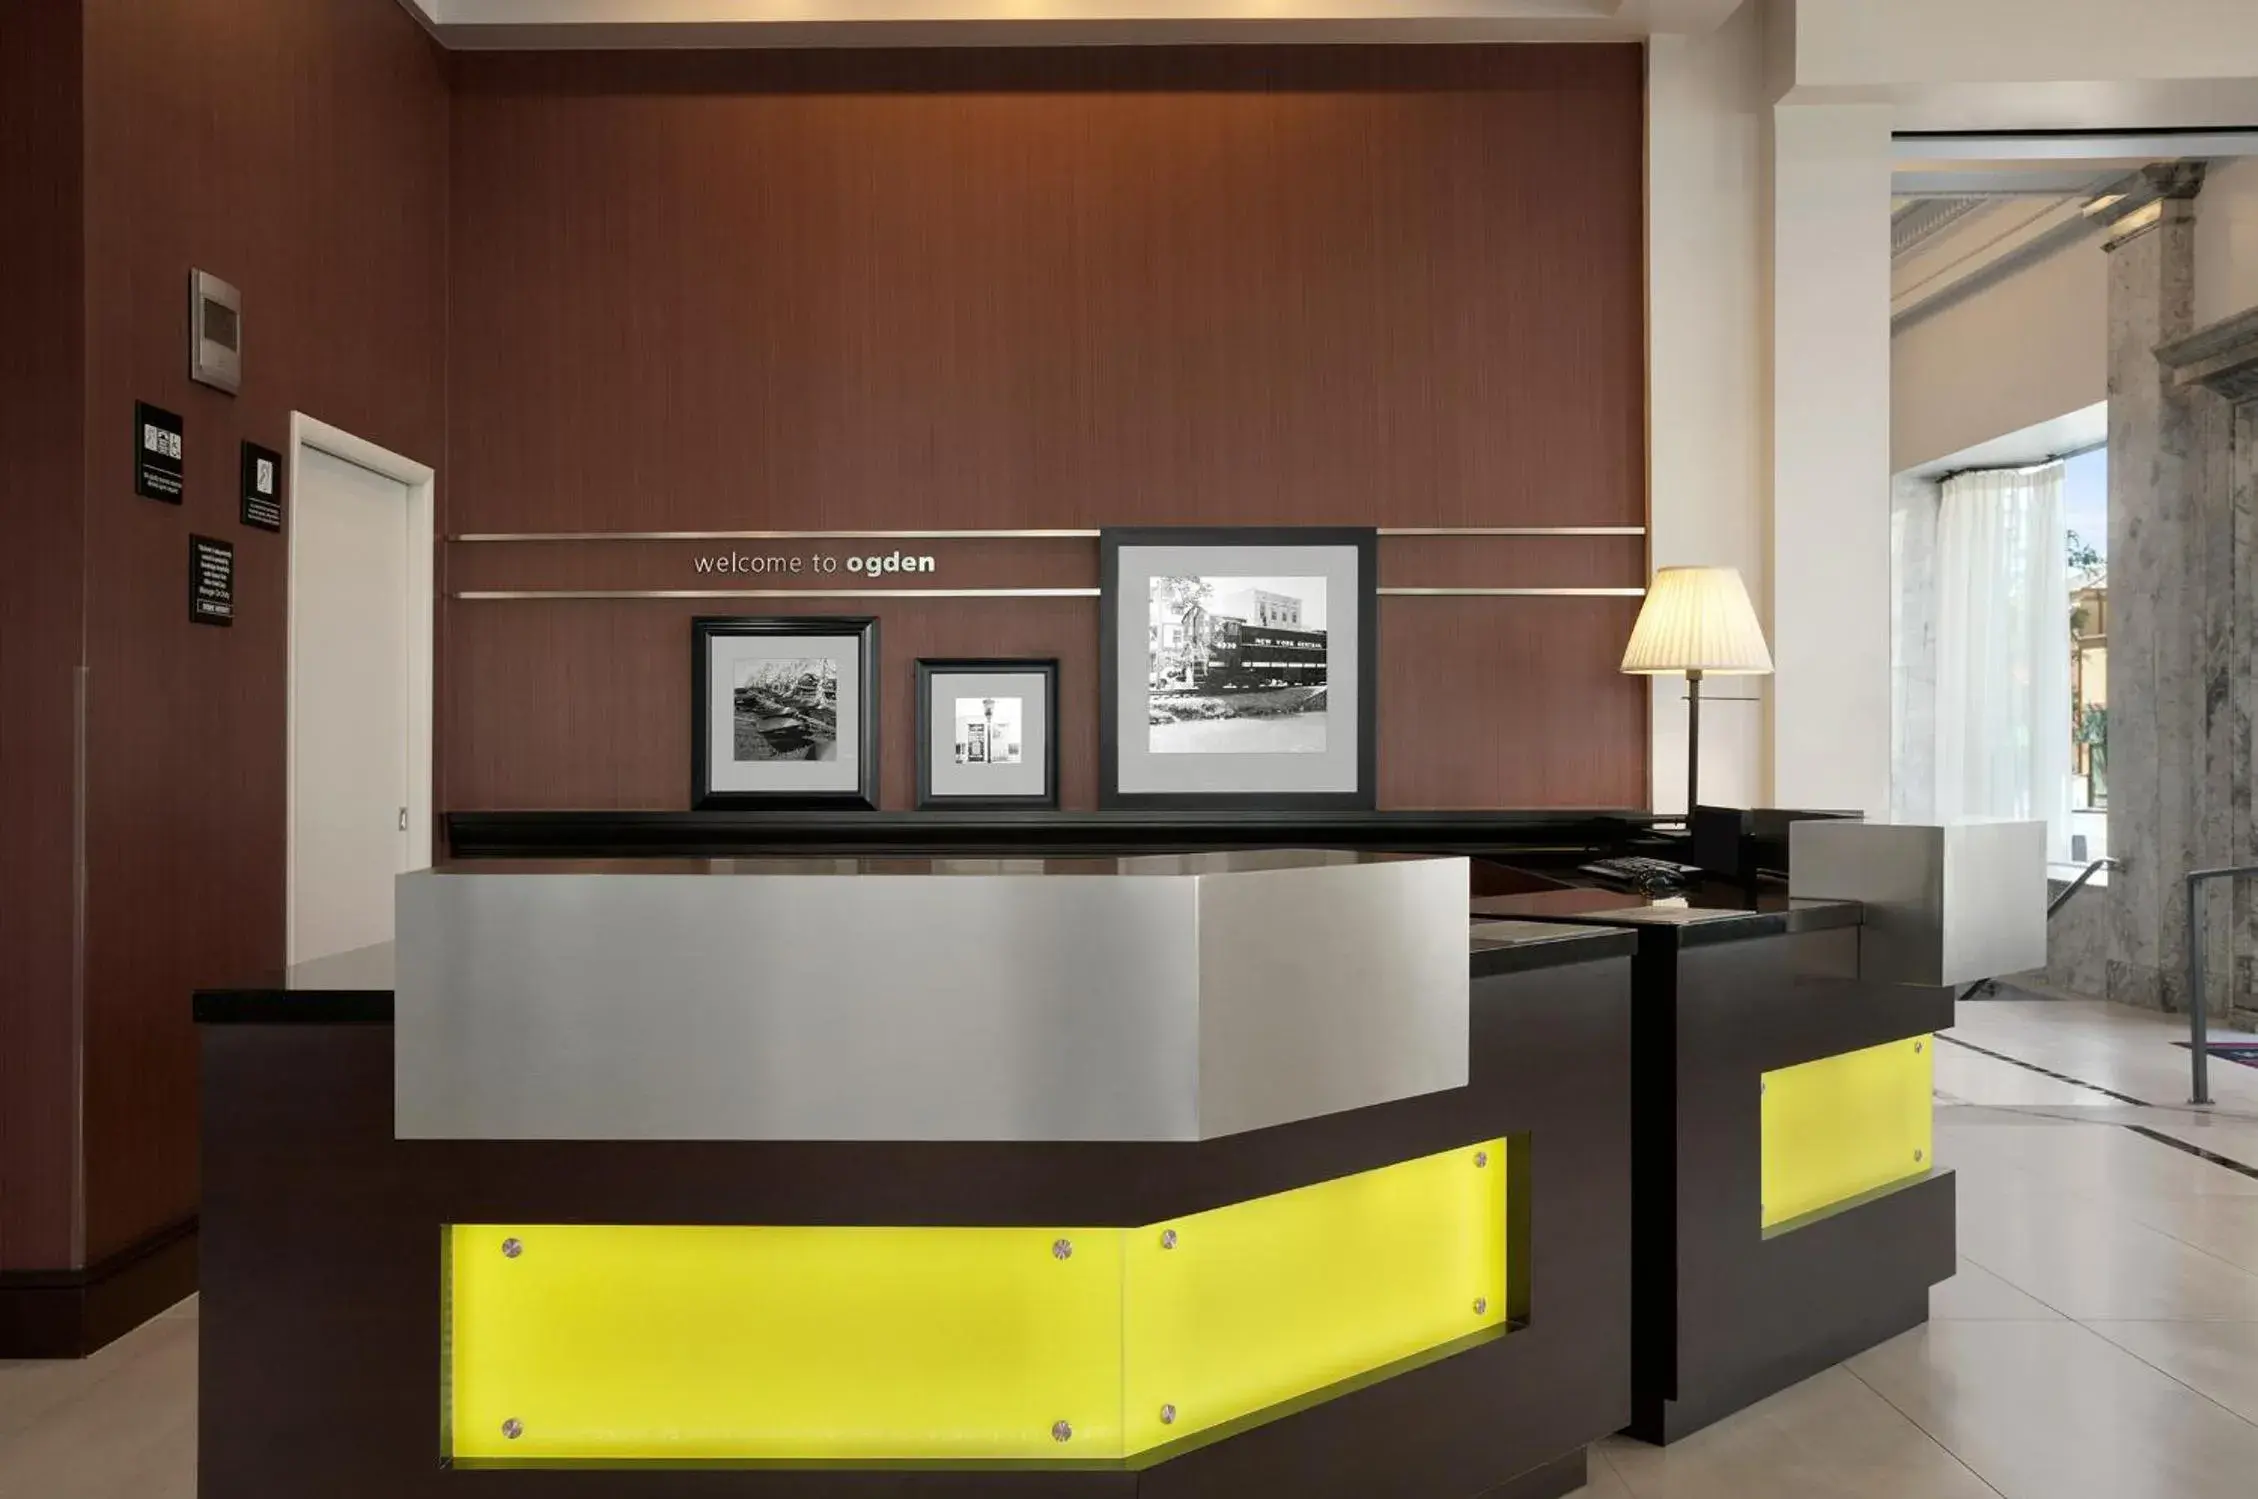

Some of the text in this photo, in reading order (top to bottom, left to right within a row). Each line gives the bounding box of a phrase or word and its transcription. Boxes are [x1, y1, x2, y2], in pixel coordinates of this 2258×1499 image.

[694, 550, 936, 577] welcome to ogden
[1276, 639, 1294, 647] YORK
